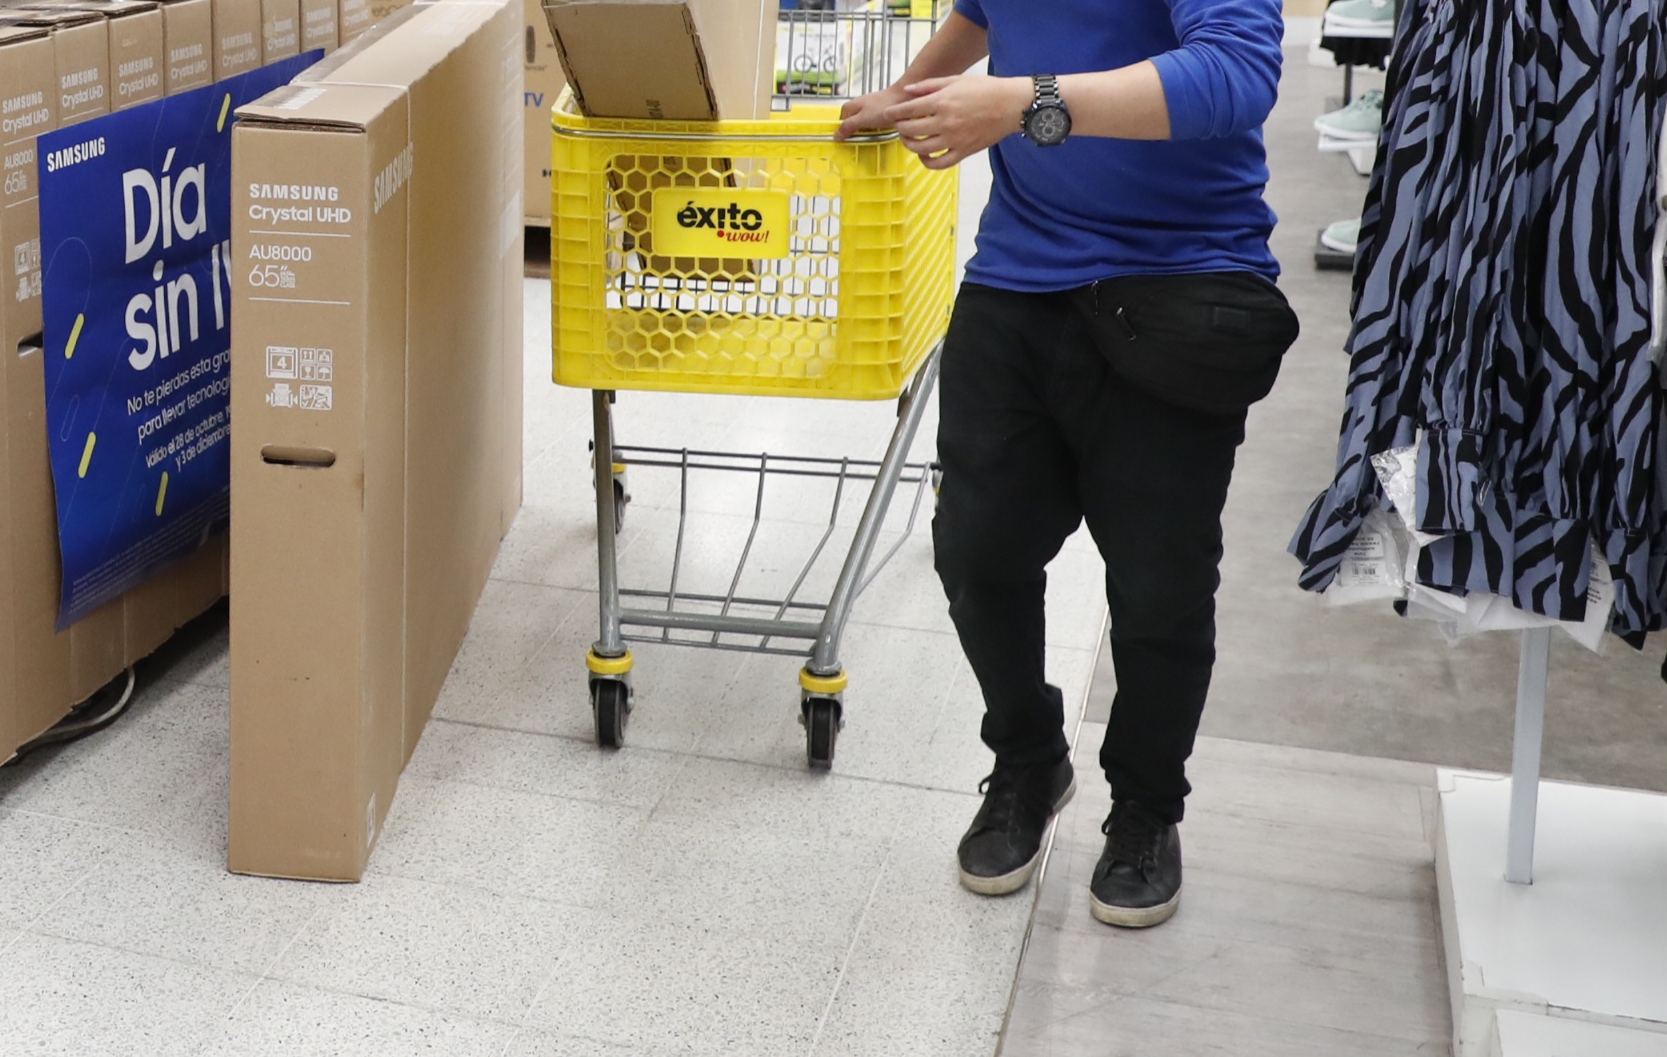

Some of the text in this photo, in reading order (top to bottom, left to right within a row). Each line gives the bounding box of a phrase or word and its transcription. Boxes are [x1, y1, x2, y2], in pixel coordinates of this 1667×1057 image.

[62, 68, 98, 89] SAMSUNG
[2, 92, 43, 114] SAMSUNG
[62, 85, 104, 109] Crystal UHD
[3, 108, 49, 134] Crystal UHD
[4, 149, 33, 170] AU8000
[47, 136, 106, 173] SAMSUNG
[374, 142, 414, 215] SAMSUNG
[249, 183, 339, 202] SAMSUNG
[122, 147, 207, 264] Día
[249, 204, 351, 226] Crystal UHD
[676, 200, 763, 238] éxito
[725, 230, 770, 245] wow!
[249, 244, 312, 262] AU8000
[125, 260, 198, 371] sin
[127, 358, 211, 416] No te pierdas esta
[138, 399, 186, 445] para llevar
